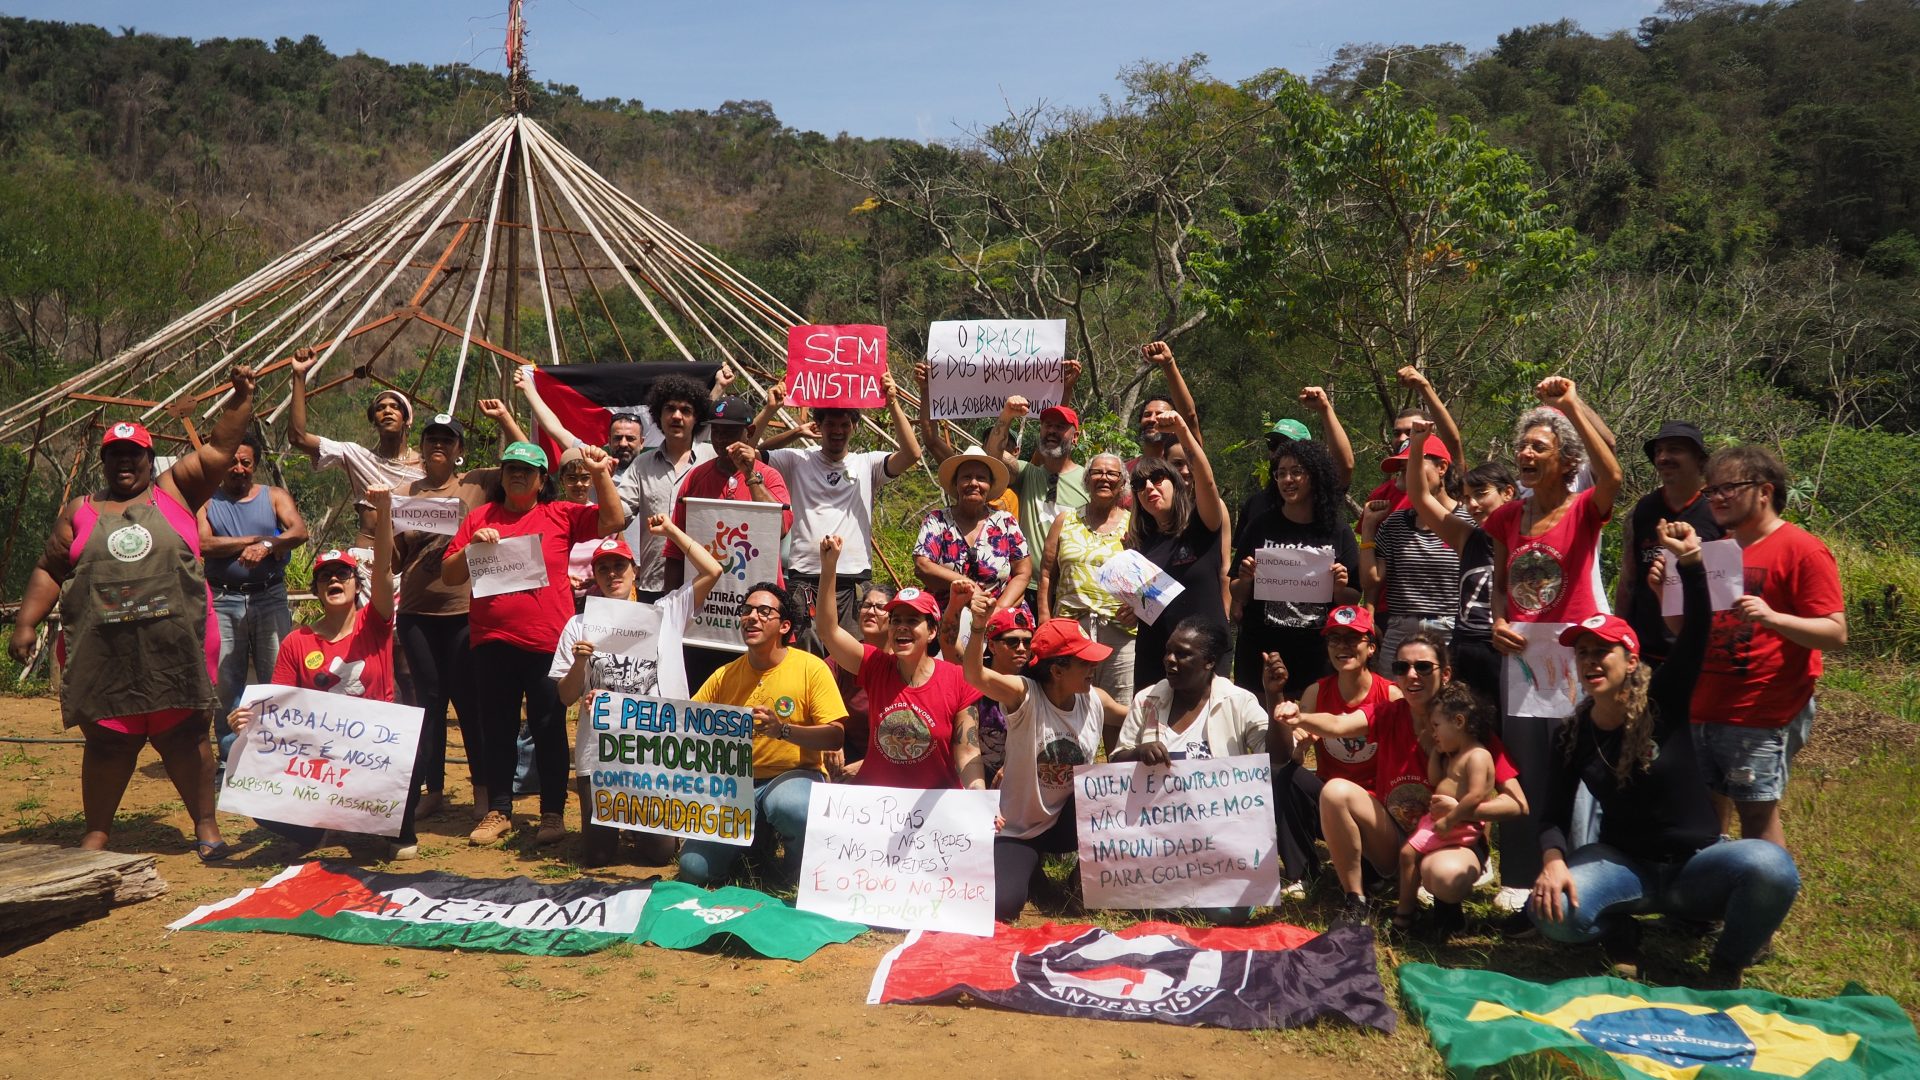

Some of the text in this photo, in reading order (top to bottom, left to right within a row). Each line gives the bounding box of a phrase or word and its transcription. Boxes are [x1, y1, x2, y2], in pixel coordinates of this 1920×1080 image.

[804, 332, 879, 366] SEM
[958, 325, 1041, 357] O BRASIL
[930, 349, 1064, 384] É DOS BRASILEIROS!
[789, 369, 880, 401] ANISTIA
[932, 395, 959, 417] PELA
[407, 520, 437, 529] NÃO!
[469, 555, 501, 567] BRASIL
[471, 562, 525, 578] SOBERANO!
[1256, 577, 1299, 587] CORRUPTO
[703, 603, 742, 618] MENINA
[706, 591, 745, 604] UTIRÃO
[583, 624, 647, 640] FORA TRUMP!
[705, 616, 732, 629] VALE
[250, 696, 401, 745] TRABALHO DE
[593, 691, 611, 731] É
[620, 697, 676, 733] PELA
[684, 706, 753, 740] NOSSA
[257, 730, 393, 771] BASE É NOSSA
[284, 756, 352, 788] LUTA!
[592, 770, 738, 799] CONTRA A PEC DA
[1084, 774, 1137, 801] QUEM
[1146, 770, 1156, 793] É
[226, 775, 400, 819] GOLPISTAS NÃO PASSARÃO!
[823, 791, 871, 824] NAS
[1091, 795, 1265, 833] NÃO ACEITAREMOS
[838, 837, 867, 861] NAS
[897, 829, 972, 854] NAS REDES
[812, 861, 829, 892] É
[909, 880, 932, 896] NO
[1100, 867, 1146, 888] PARA
